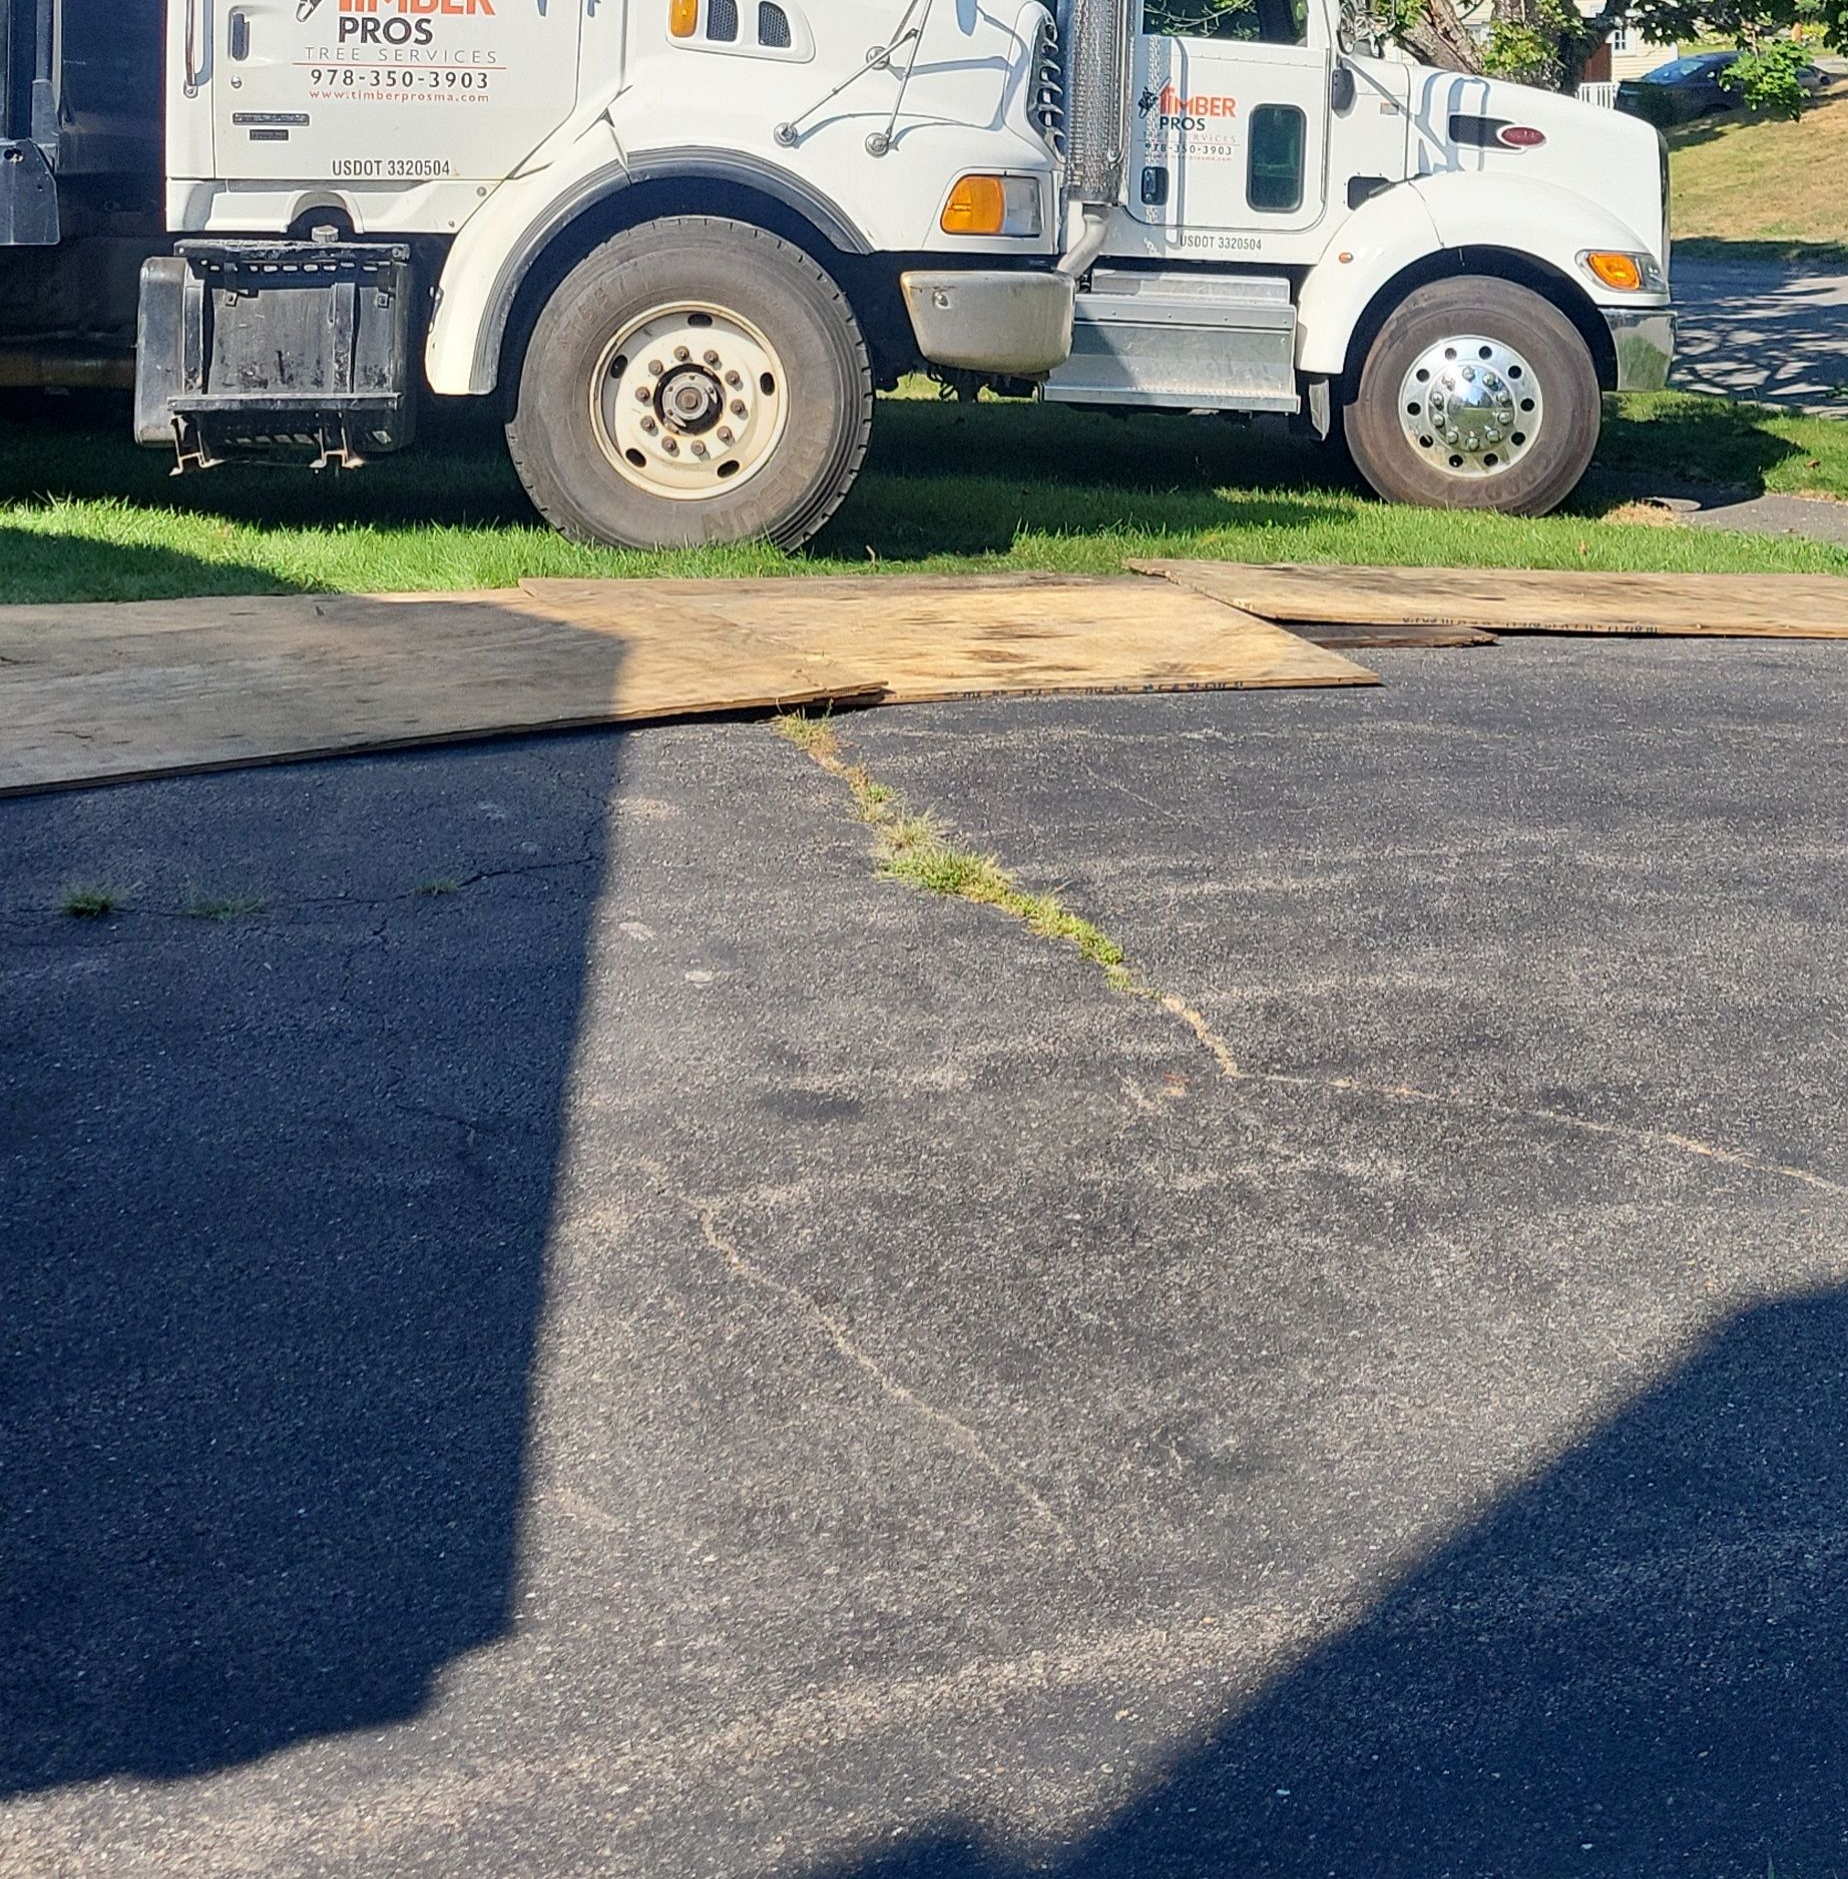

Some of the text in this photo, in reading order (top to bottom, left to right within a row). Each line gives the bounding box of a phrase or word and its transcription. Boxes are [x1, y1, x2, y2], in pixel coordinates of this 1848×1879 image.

[338, 16, 434, 45] PROS
[305, 46, 497, 64] TREE SERVICES
[310, 69, 489, 89] 978-350-3903
[309, 89, 490, 103] www.timberprosma.com
[1160, 86, 1237, 118] TIMBER
[1159, 116, 1206, 132] PROS
[332, 159, 450, 176] USDOT 3320504
[1180, 234, 1262, 250] USDOT 3320504
